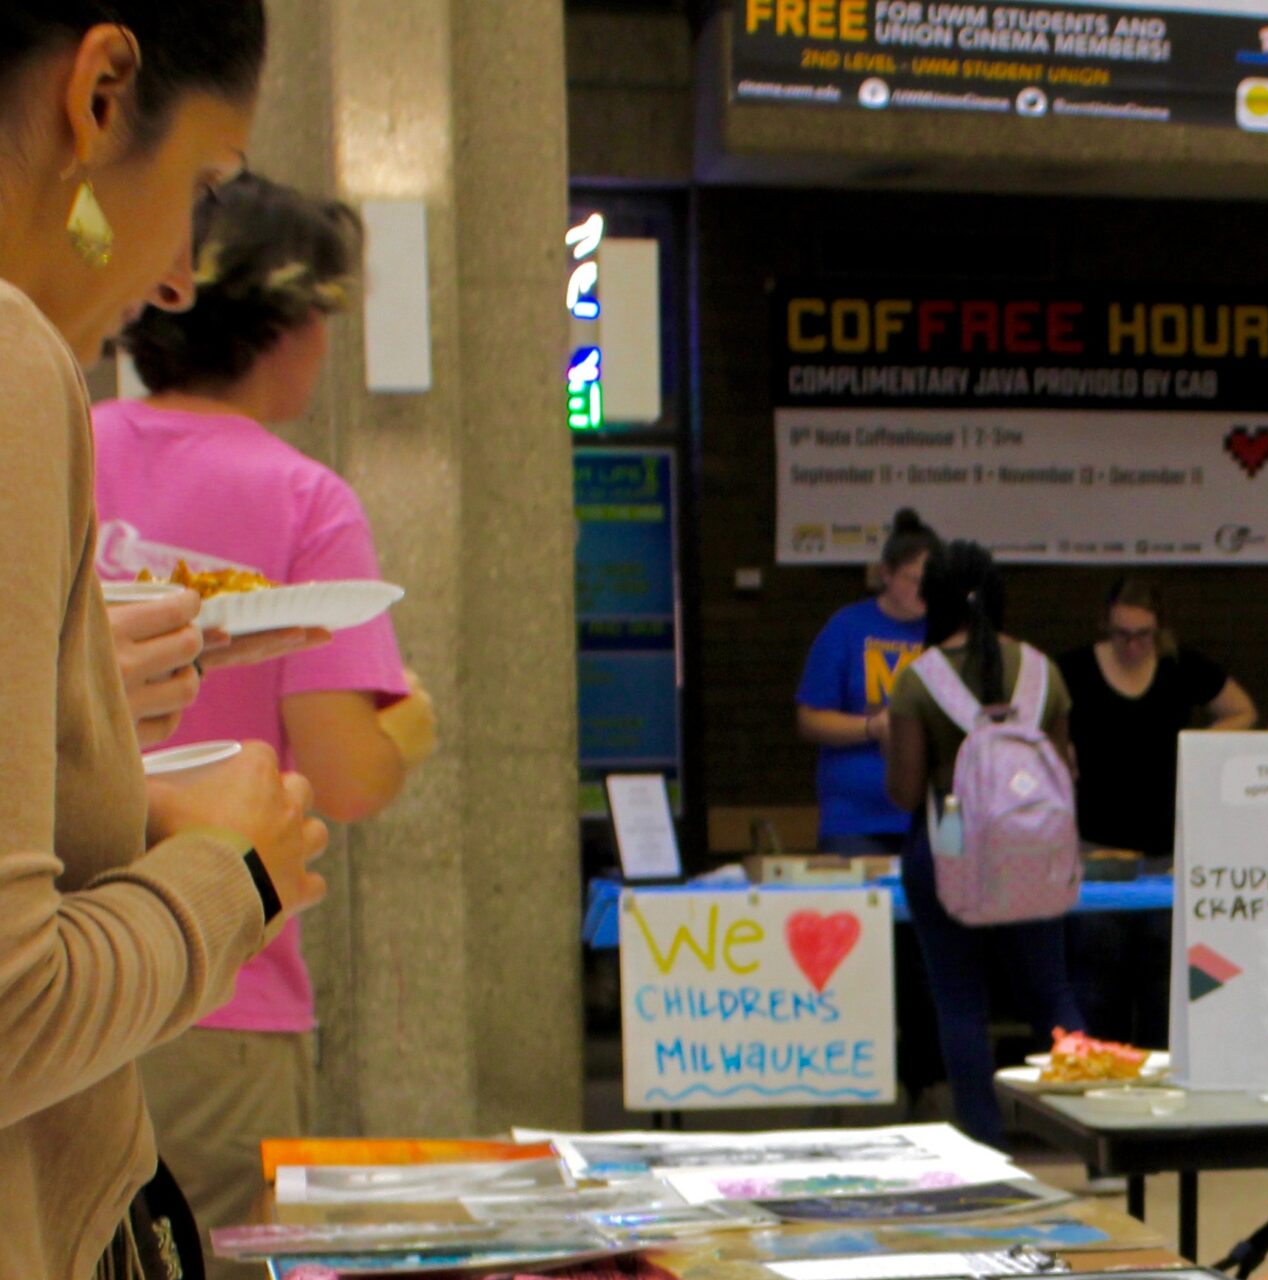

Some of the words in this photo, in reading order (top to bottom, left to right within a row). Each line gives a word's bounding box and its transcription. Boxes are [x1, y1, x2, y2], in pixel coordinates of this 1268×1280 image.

[745, 0, 869, 41] FREE
[875, 5, 922, 25] FOR
[929, 7, 988, 27] UWM
[993, 10, 1109, 36] STUDENTS
[1114, 17, 1167, 38] AND
[875, 23, 952, 47] UNION
[958, 28, 1051, 53] CINEMA
[1055, 35, 1171, 61] MEMBERS!
[801, 49, 841, 70] 2ND
[843, 51, 897, 74] LEVEL
[911, 57, 960, 77] UWM
[962, 58, 1044, 81] STUDENT
[1048, 66, 1111, 87] UNION
[786, 298, 1085, 355] COFFREE
[788, 364, 971, 397] COMPLIMENTARY
[973, 366, 1030, 397] JAVA
[1033, 367, 1139, 398] PROVIDED
[1142, 368, 1172, 398] BY
[790, 464, 875, 486] September
[907, 464, 968, 484] October
[998, 465, 1075, 485] November
[1109, 465, 1187, 485] December
[628, 903, 765, 975] We
[635, 985, 840, 1022] CHILDRENS
